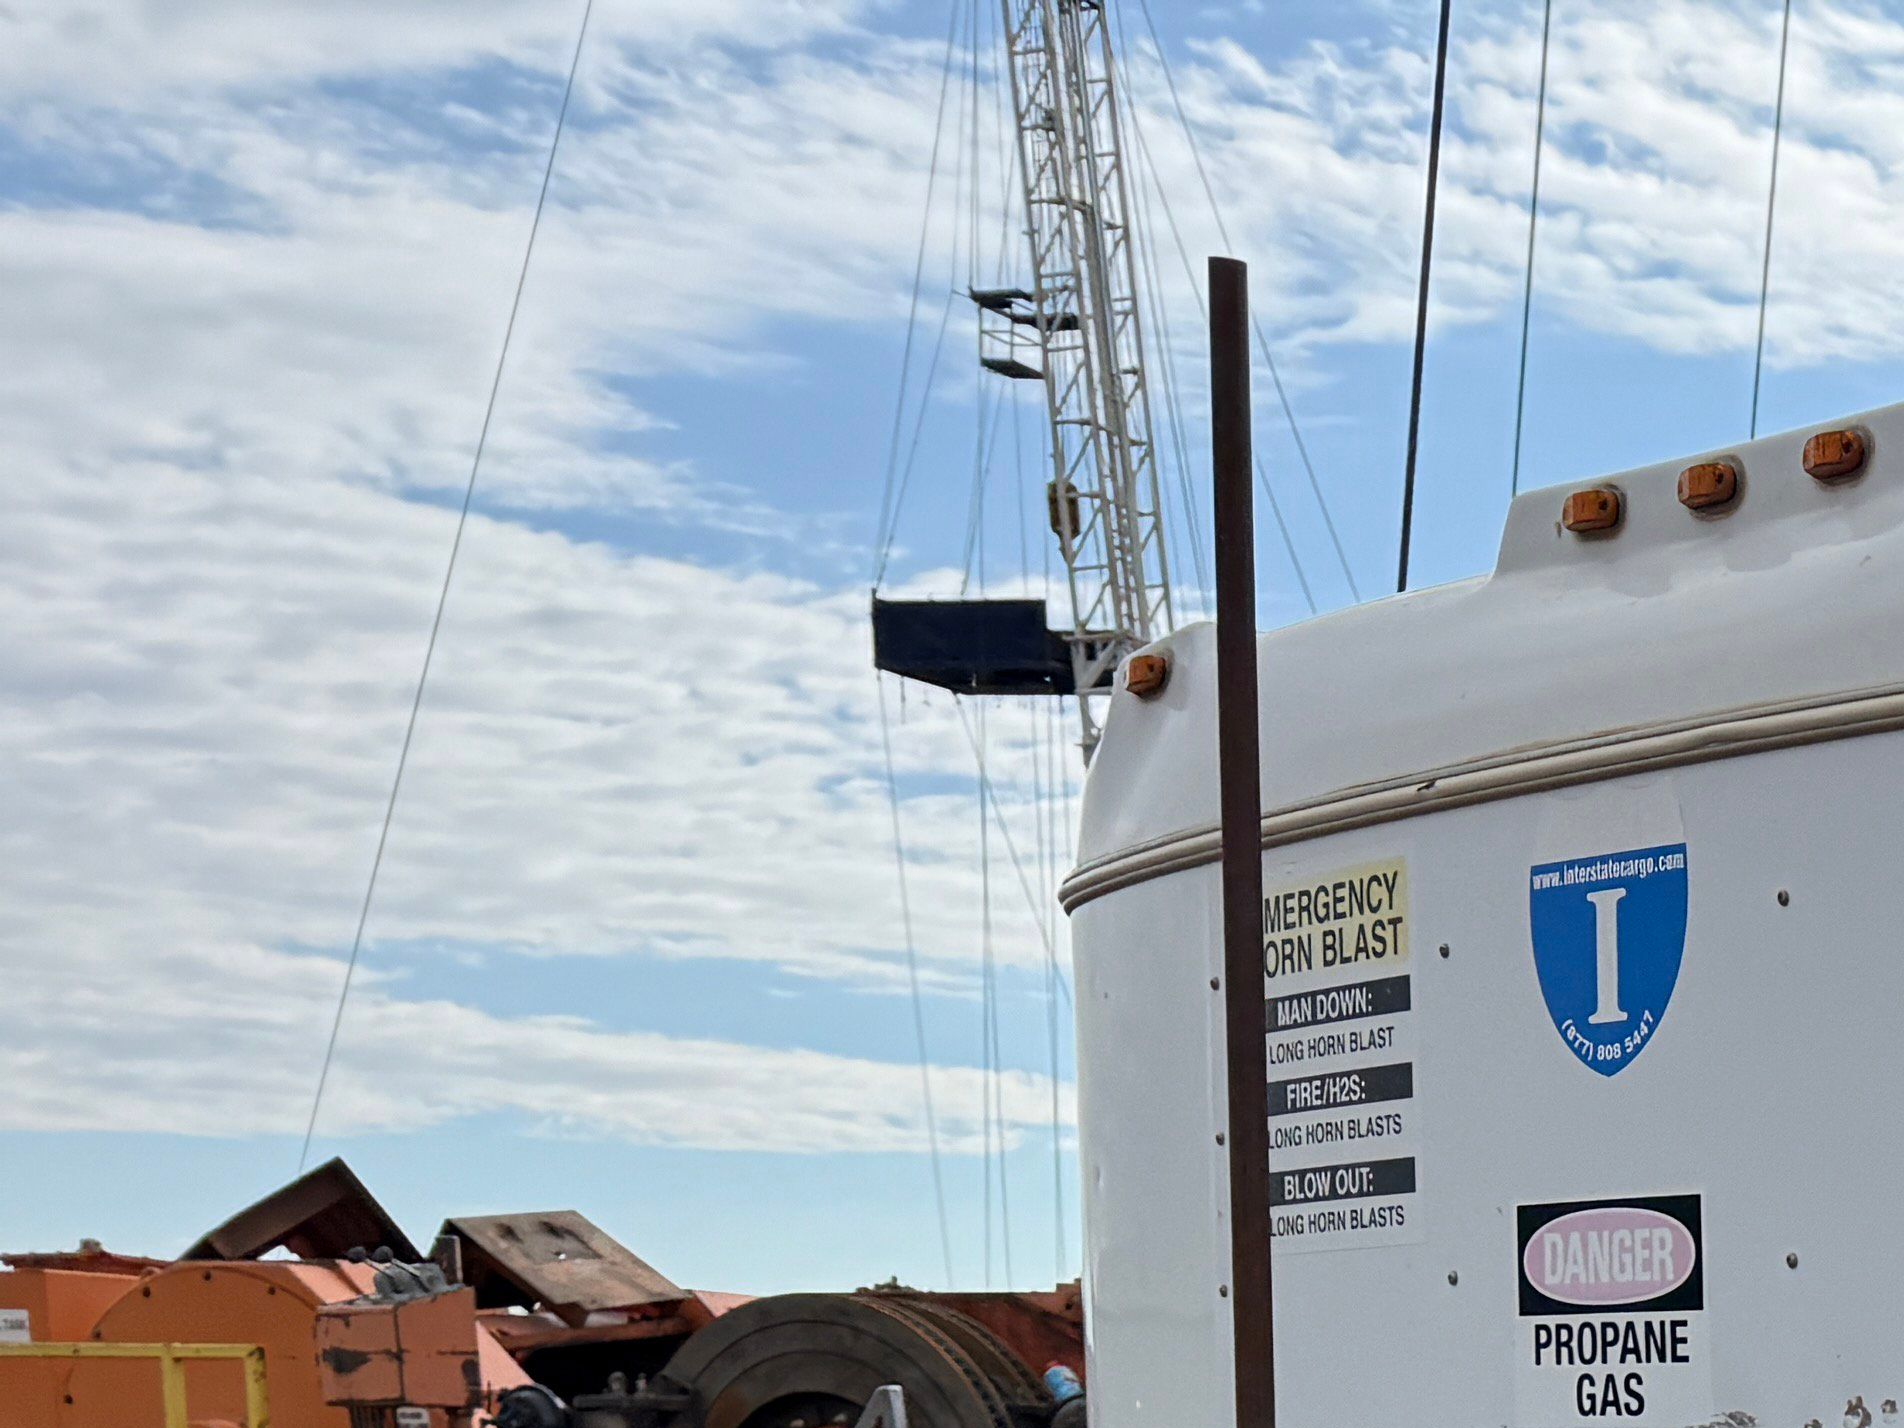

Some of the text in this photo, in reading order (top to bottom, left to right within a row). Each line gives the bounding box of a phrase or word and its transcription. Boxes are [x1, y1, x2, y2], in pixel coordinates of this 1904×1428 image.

[1264, 870, 1398, 934] MERGENCY
[1264, 916, 1403, 979] ORN BLAST
[1277, 987, 1373, 1027] MAN DOWN:
[1269, 1026, 1395, 1065] LONG HORN BLAST
[1562, 1010, 1654, 1061] (877) 808 5447
[1286, 1074, 1366, 1110] FIRE/H2S:
[1306, 1120, 1344, 1145] HORN
[1348, 1114, 1402, 1140] BLASTS
[1284, 1167, 1374, 1201] BLOW OUT:
[1269, 1205, 1405, 1237] LONG HORN BLASTS
[1543, 1227, 1675, 1285] DANGER
[1534, 1320, 1690, 1366] PROPANE
[1576, 1373, 1645, 1417] GAS
